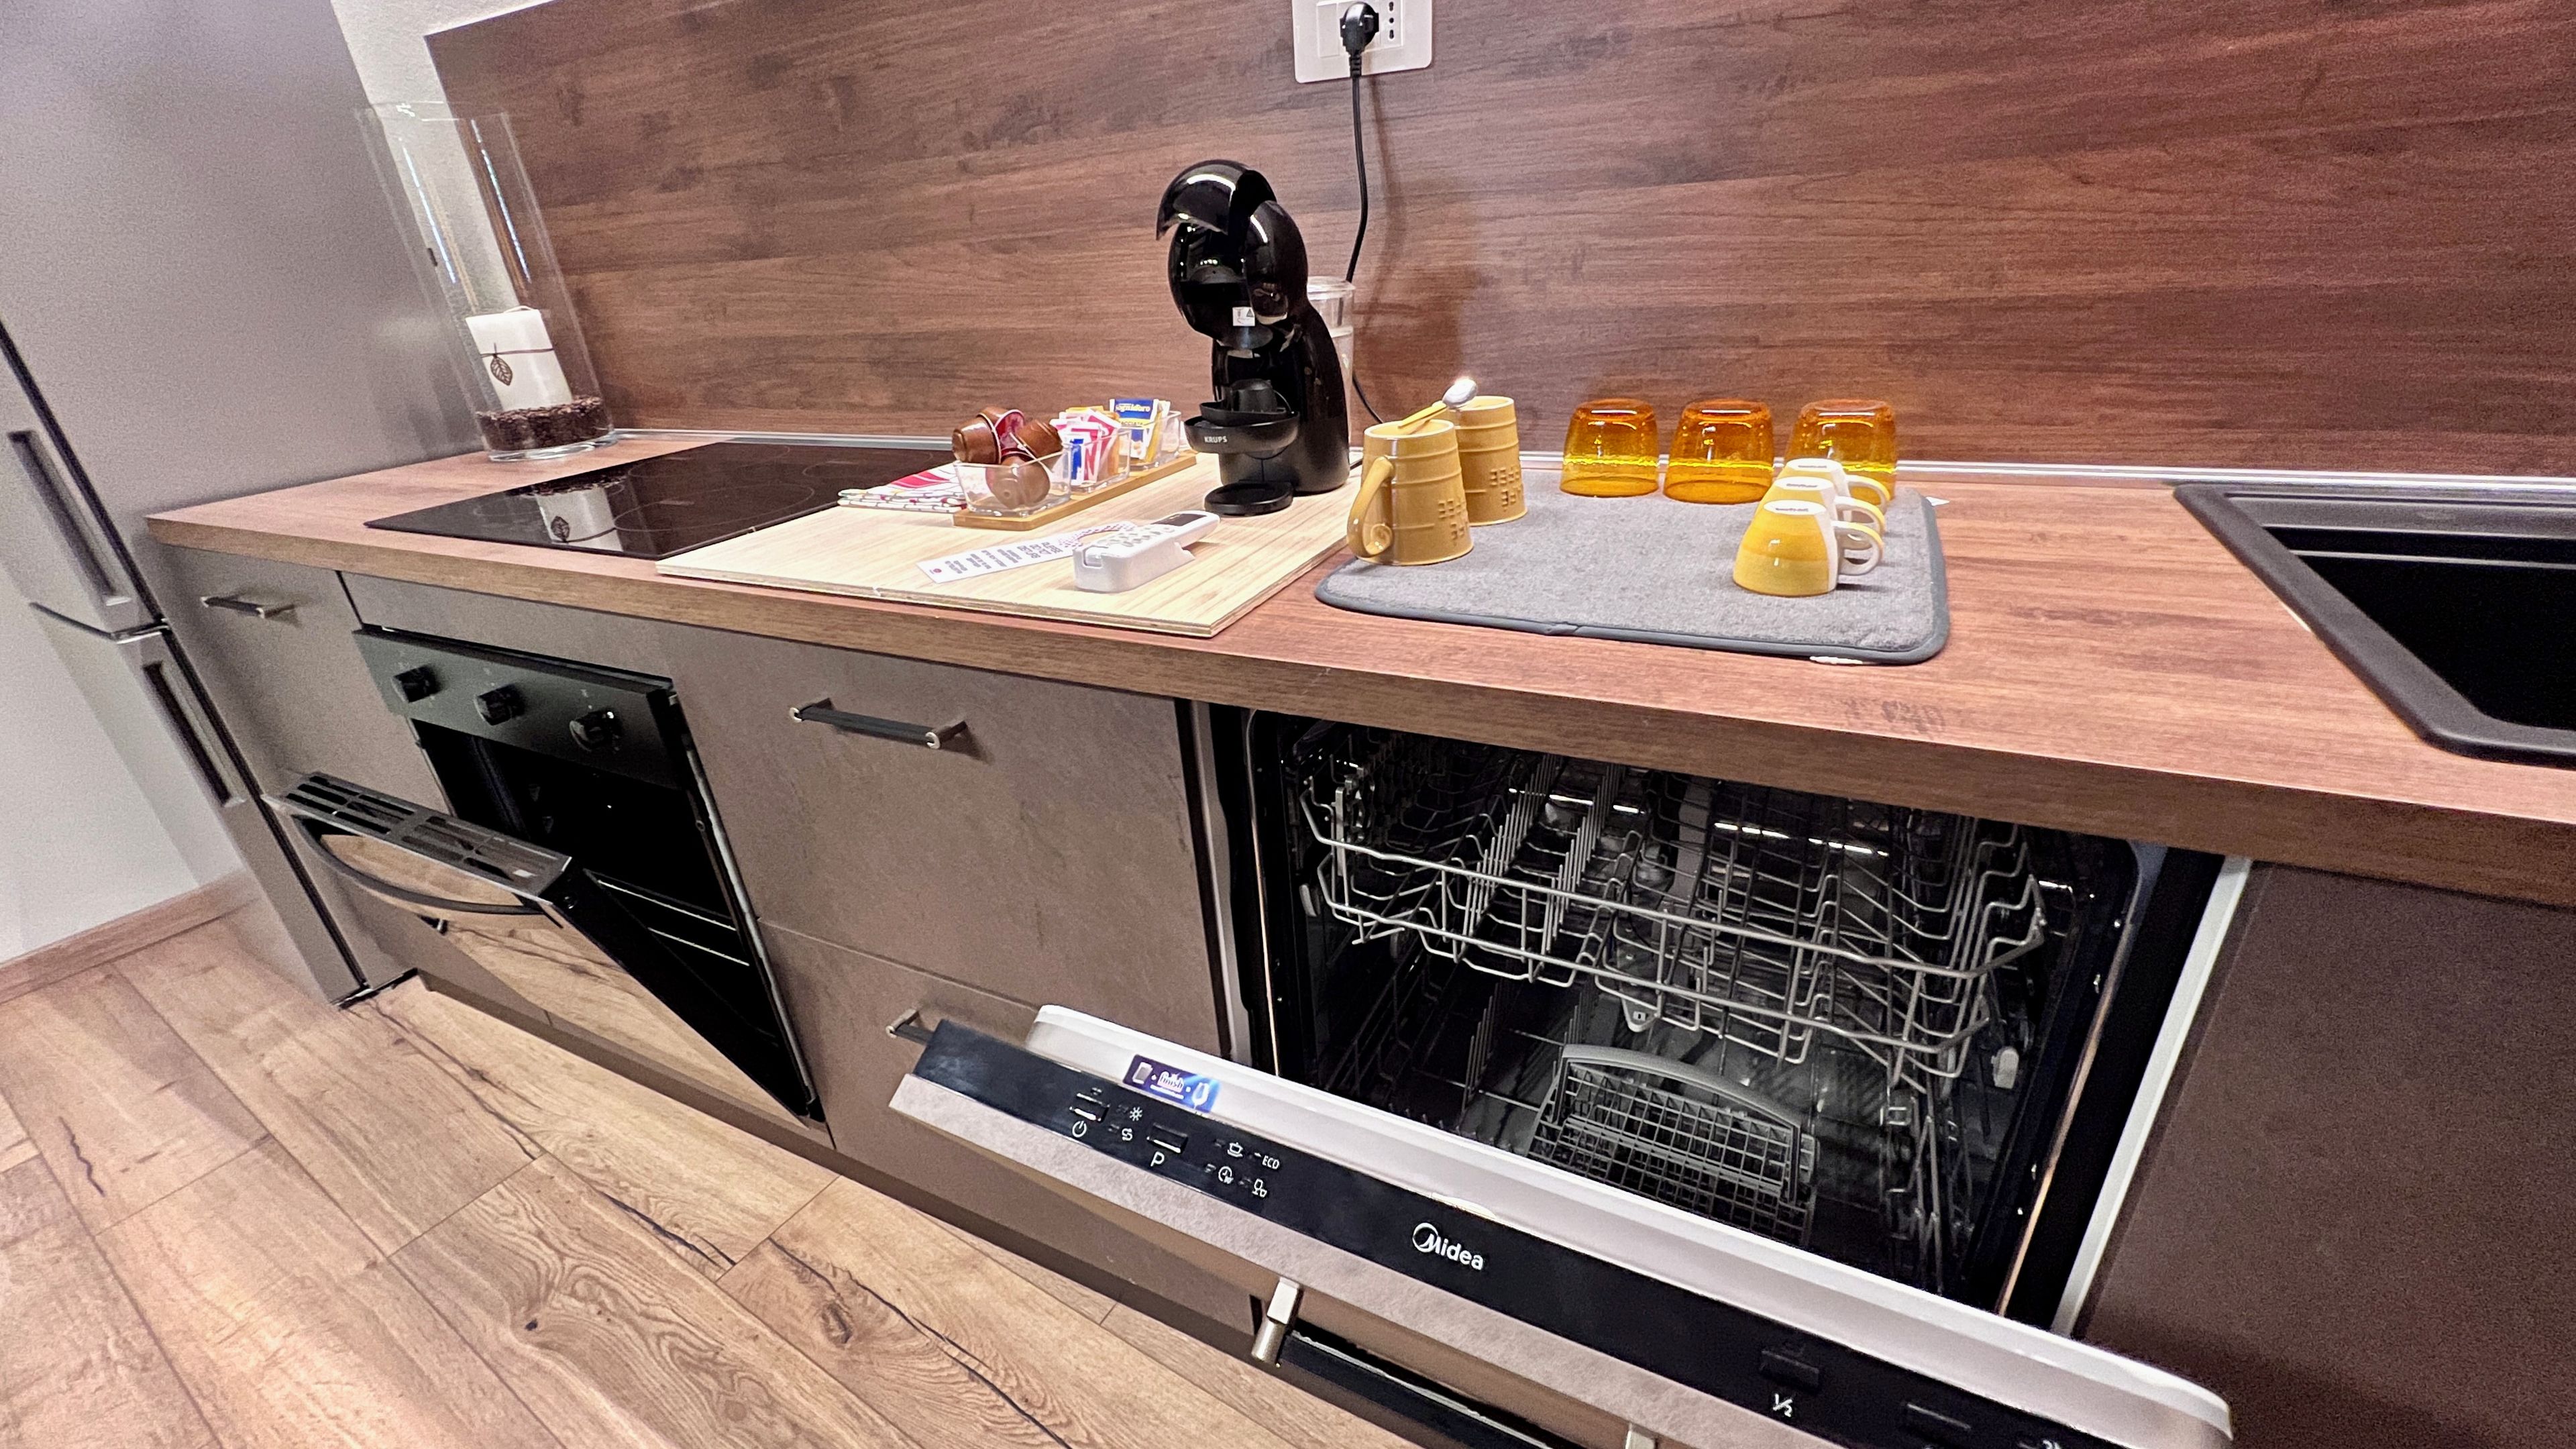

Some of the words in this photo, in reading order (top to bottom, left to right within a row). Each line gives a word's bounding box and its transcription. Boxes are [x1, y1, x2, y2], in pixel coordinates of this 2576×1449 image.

[1159, 1073, 1184, 1091] finish
[1150, 1151, 1165, 1167] P
[1262, 1155, 1280, 1170] ECO
[1412, 1222, 1484, 1271] Midea
